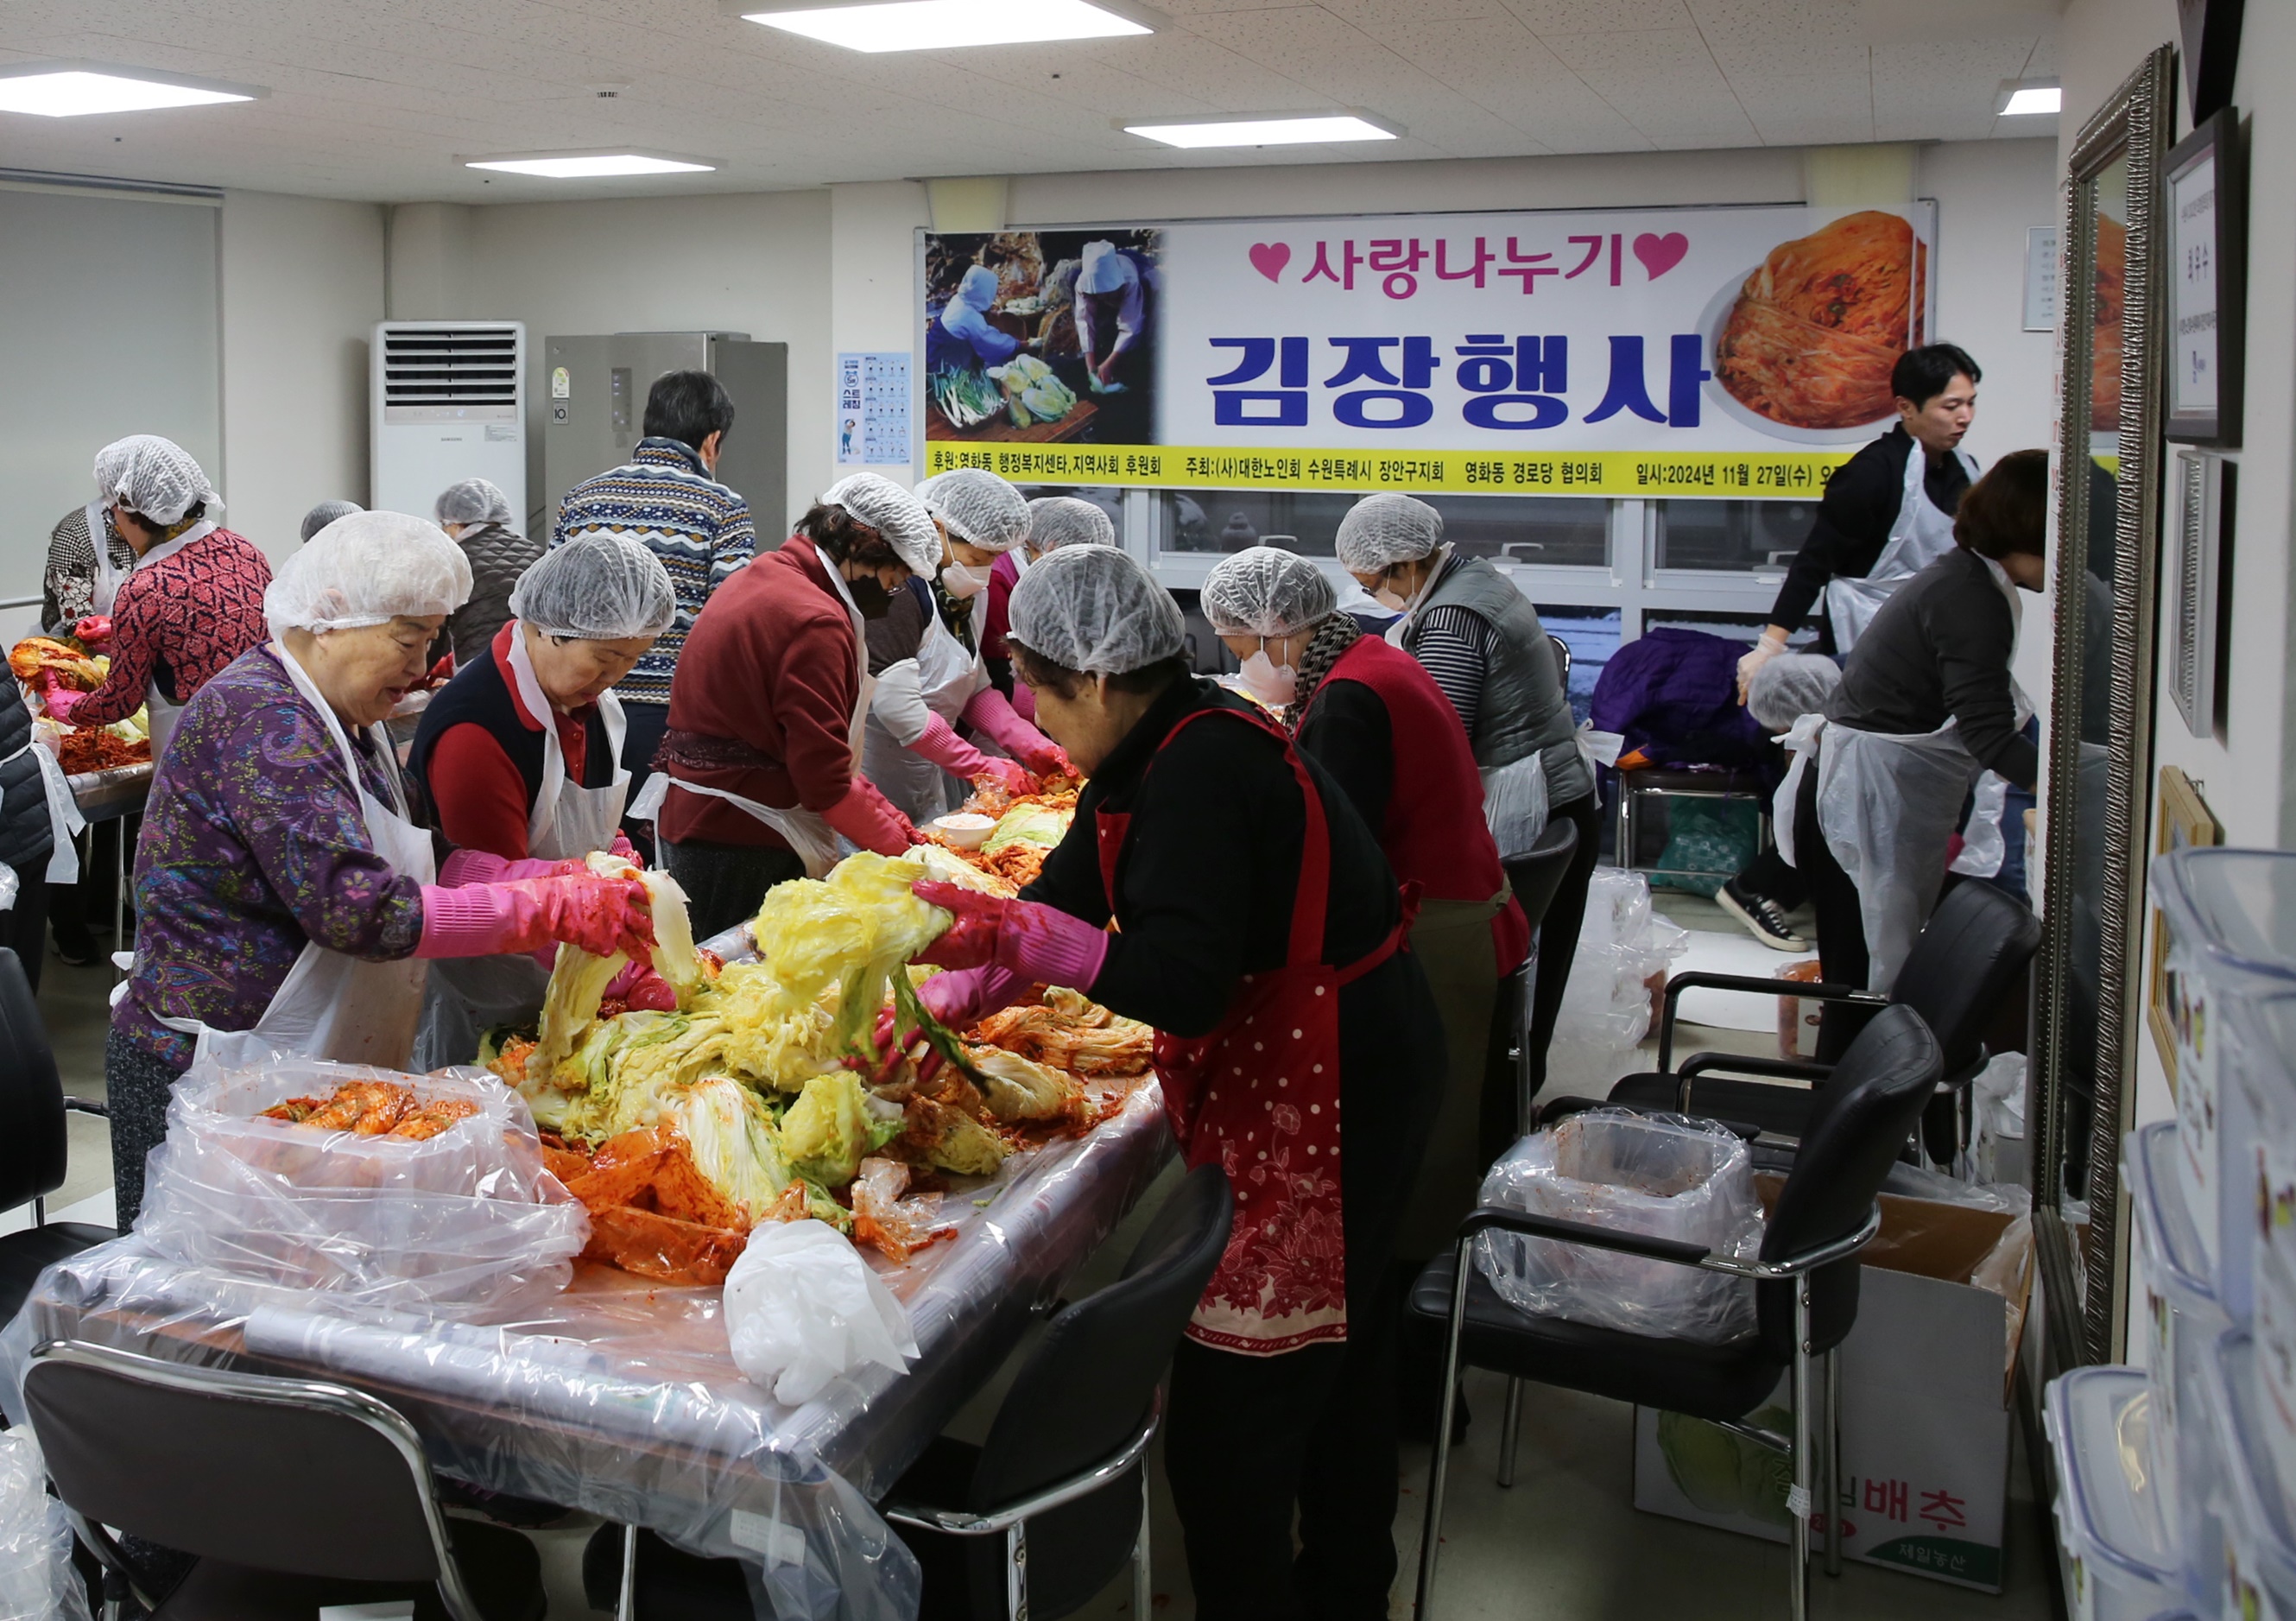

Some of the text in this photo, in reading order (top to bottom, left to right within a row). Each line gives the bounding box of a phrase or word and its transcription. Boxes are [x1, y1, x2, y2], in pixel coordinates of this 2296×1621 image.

[1301, 233, 1622, 300] 사랑나누기
[1206, 333, 1711, 430] 김장행사
[933, 450, 1842, 486] 후원:영화동 행정복지센타,지역사회 후원회 주최:(사)대한노인회 수원특례시 장안구지회 영화동 경로당 협의회 일시:2024년 11월 27일(수) 오
[1899, 1542, 1967, 1573] 제일농산
